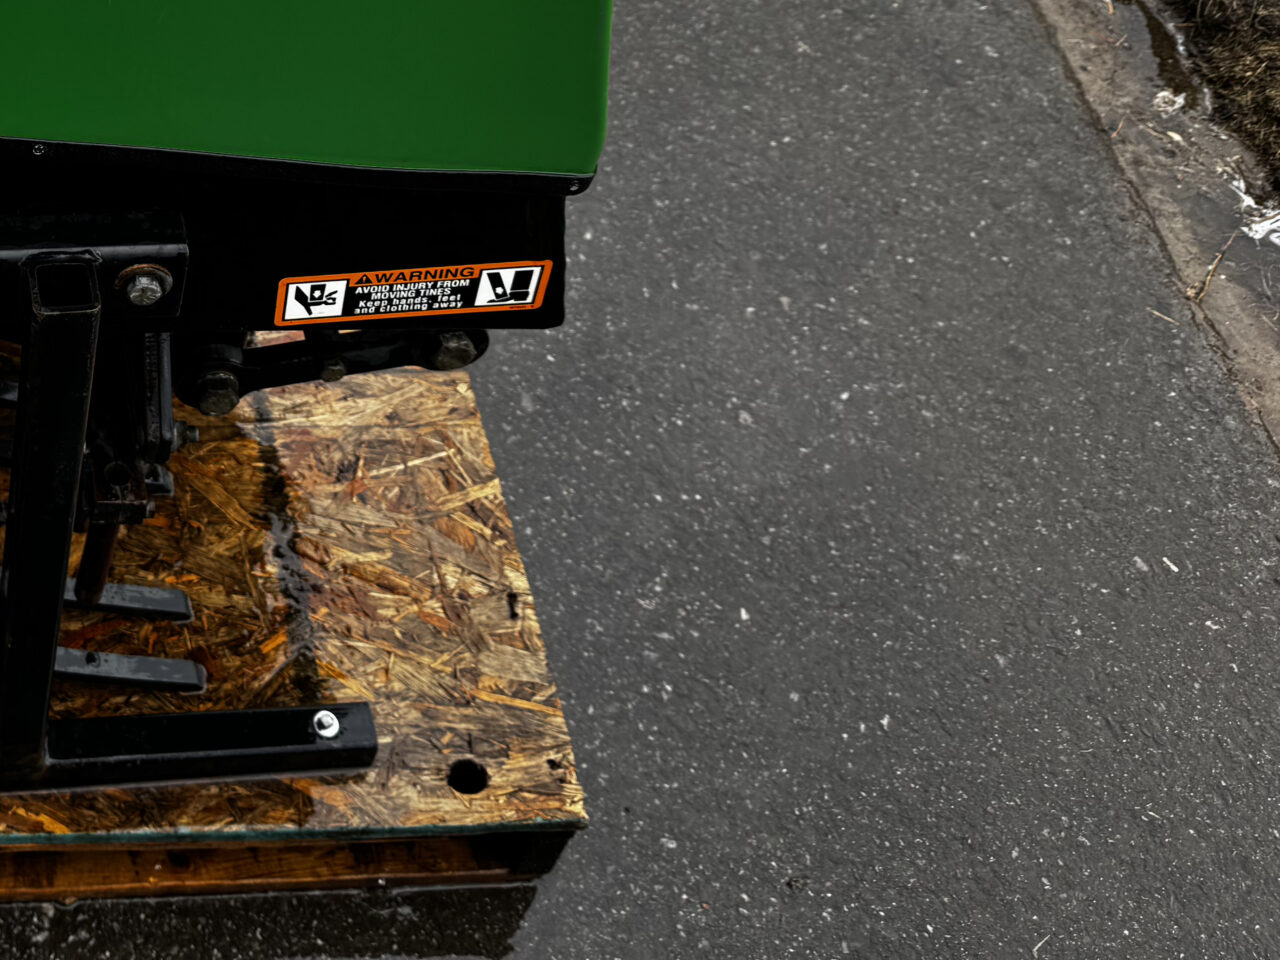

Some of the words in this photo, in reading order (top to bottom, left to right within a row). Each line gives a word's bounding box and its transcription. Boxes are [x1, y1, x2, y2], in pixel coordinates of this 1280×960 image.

[375, 267, 475, 283] WARNING
[355, 285, 390, 294] AVOID
[392, 281, 434, 291] INJURY
[436, 279, 470, 288] FROM
[371, 290, 416, 300] MOVING
[419, 287, 451, 296] TINES
[354, 306, 376, 314] and
[379, 303, 428, 312] clothing
[432, 301, 463, 309] away
[358, 300, 388, 308] Keep
[437, 294, 461, 302] feet
